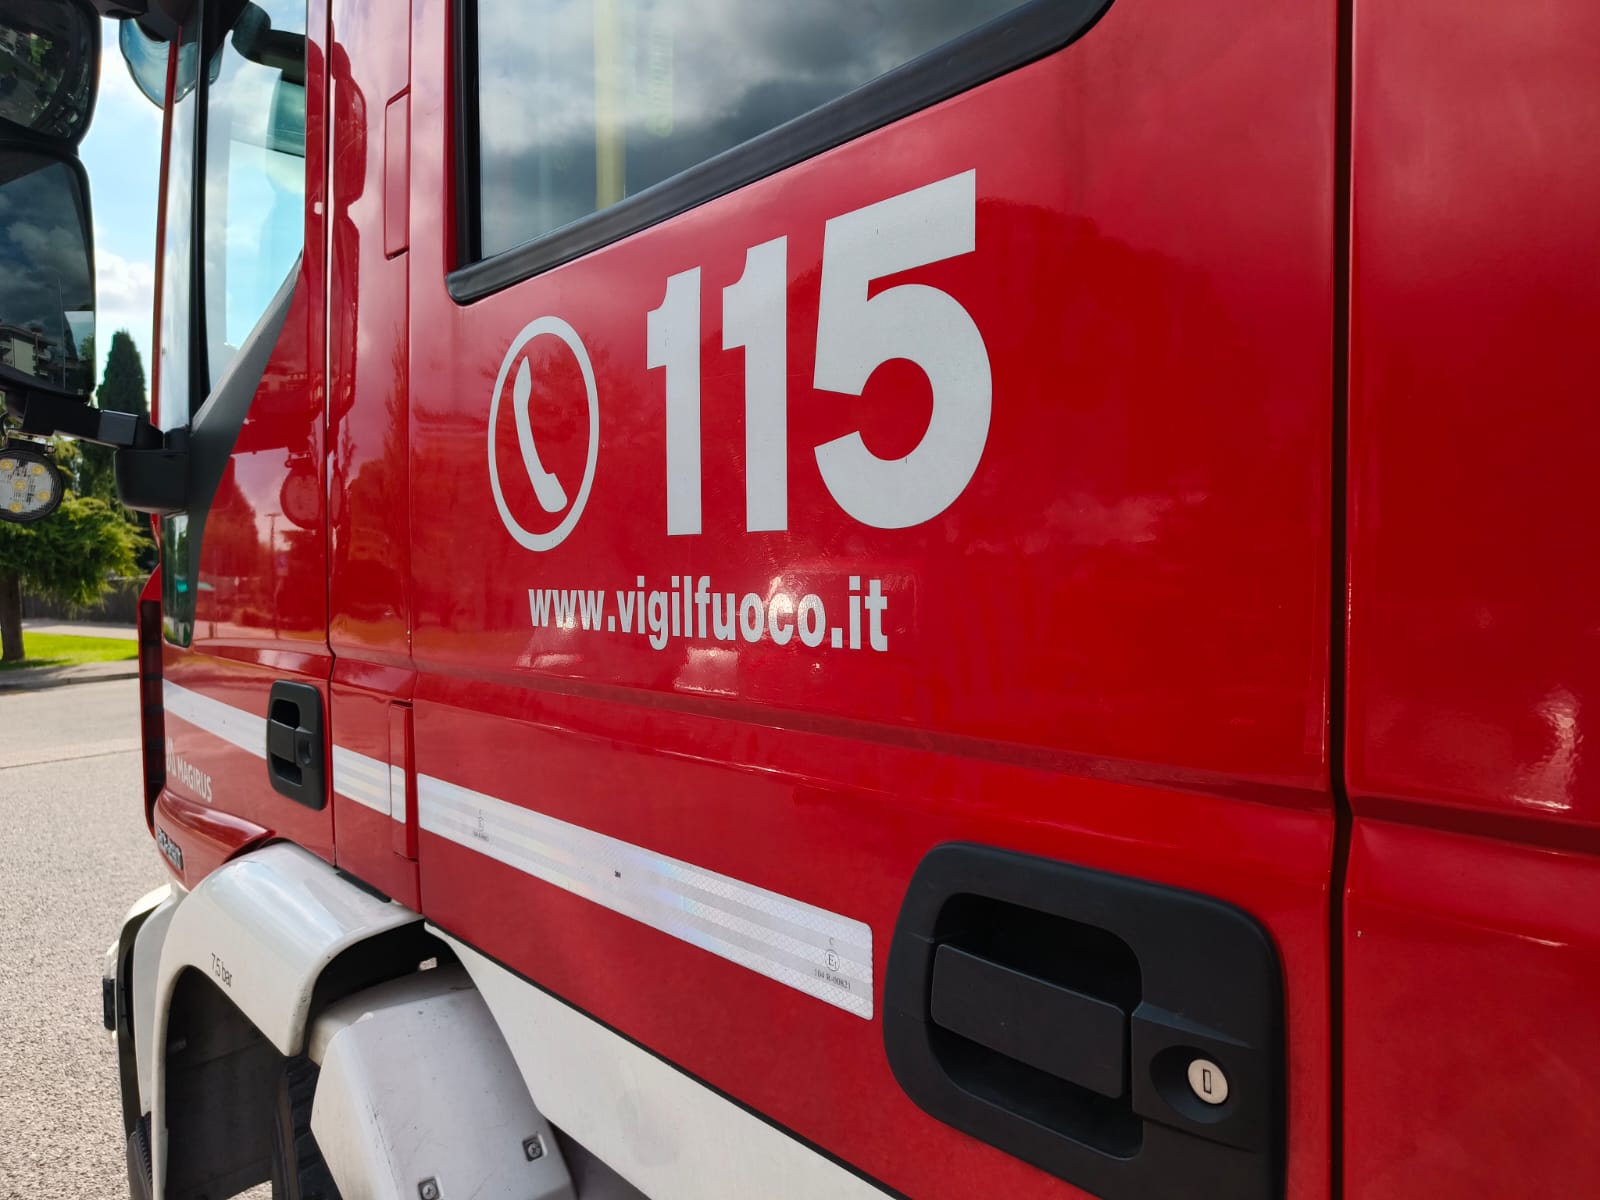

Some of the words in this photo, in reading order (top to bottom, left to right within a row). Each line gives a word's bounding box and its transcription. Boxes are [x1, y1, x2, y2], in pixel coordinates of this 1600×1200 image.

[647, 168, 993, 536] 115
[528, 575, 888, 652] www.vigilfuoco.it
[177, 754, 213, 803] MAGIRUS
